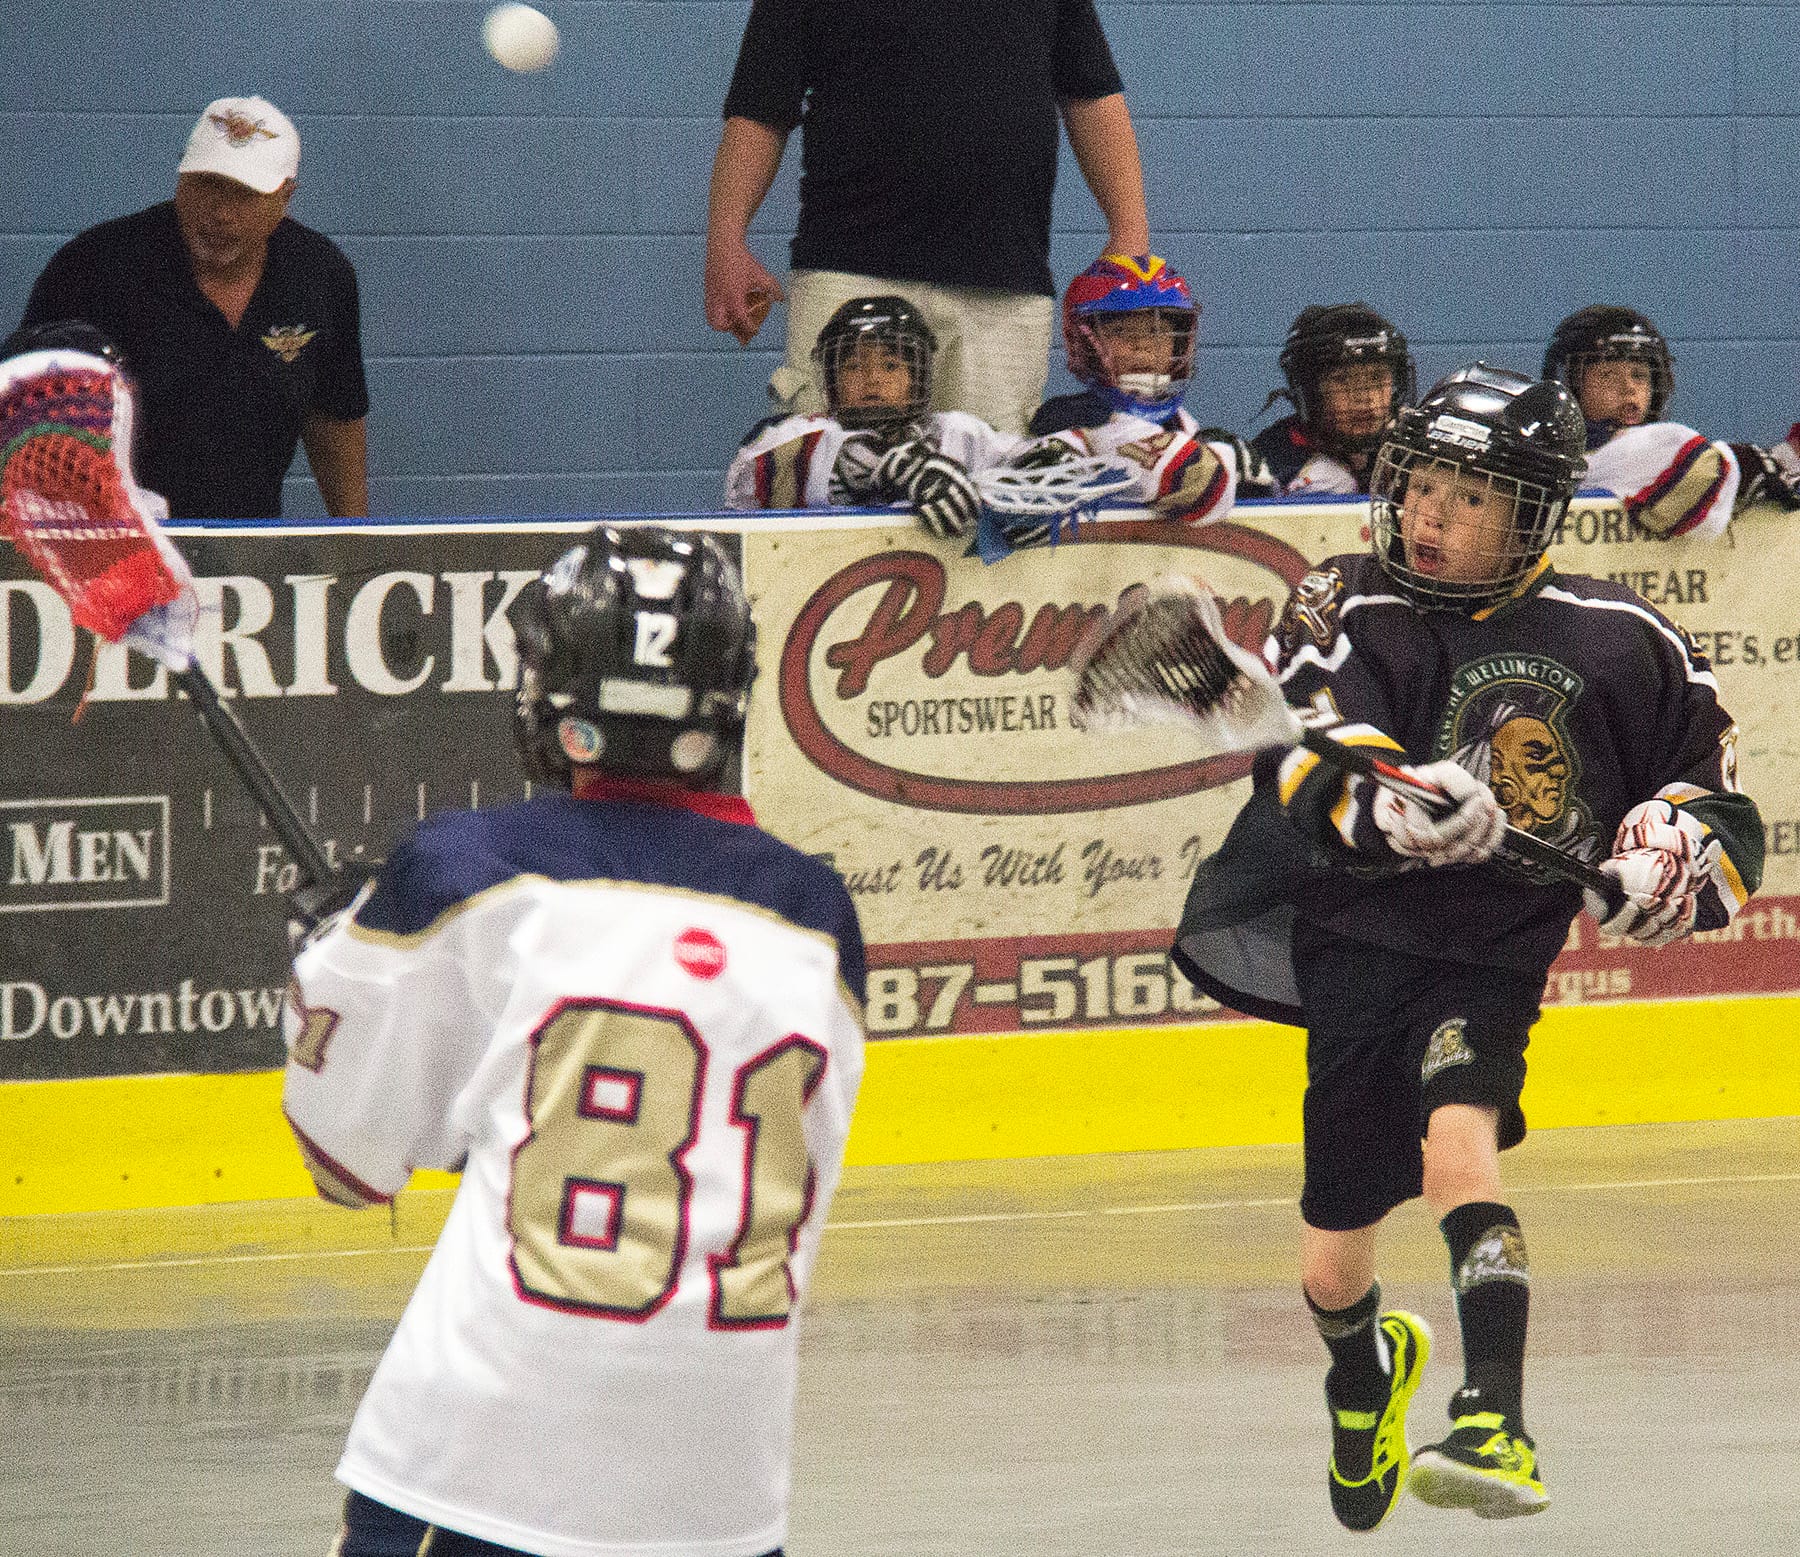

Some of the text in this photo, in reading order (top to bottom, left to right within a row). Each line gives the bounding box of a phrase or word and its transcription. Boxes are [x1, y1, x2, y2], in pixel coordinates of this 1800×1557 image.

[1465, 659, 1576, 692] WELLINGTON
[866, 695, 1057, 738] SPORTSWEAR
[915, 846, 963, 891] Us
[980, 843, 1064, 887] With
[1081, 838, 1162, 898] Your
[505, 997, 827, 1331] 81
